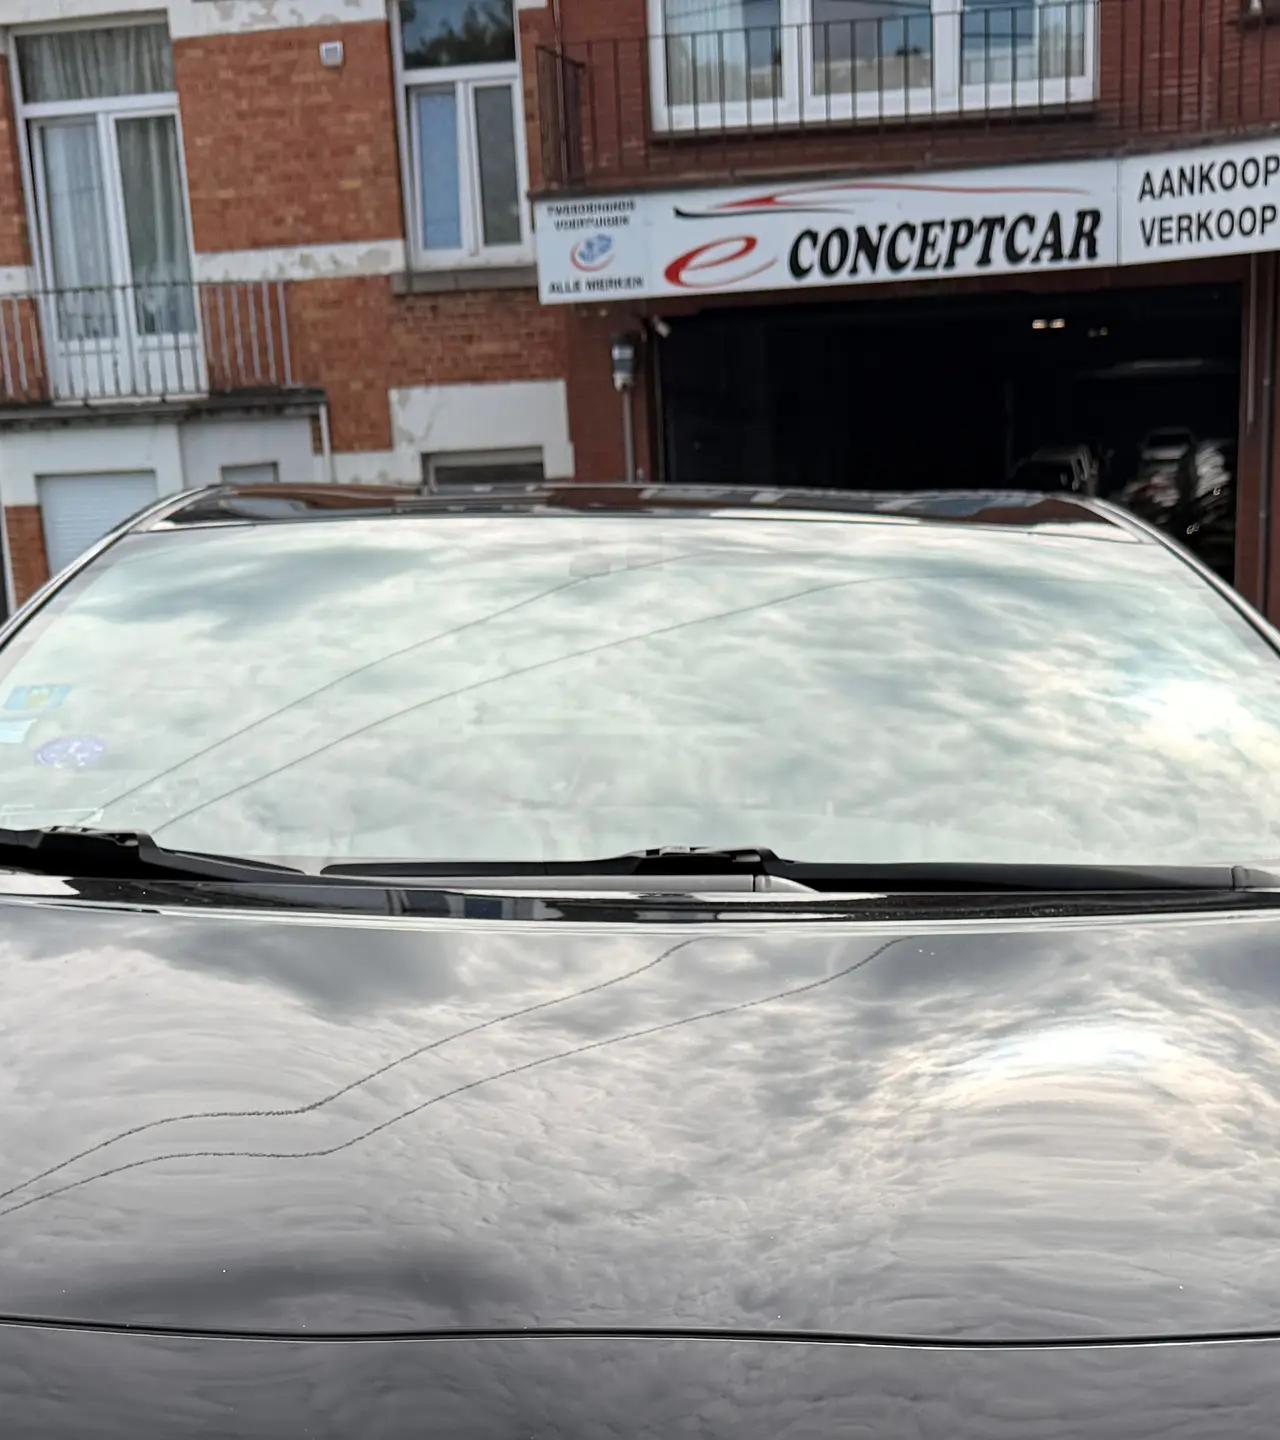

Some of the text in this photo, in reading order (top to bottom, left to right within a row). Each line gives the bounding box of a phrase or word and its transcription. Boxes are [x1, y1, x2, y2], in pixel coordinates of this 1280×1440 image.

[1138, 155, 1280, 202] AANKOOP
[1140, 203, 1277, 247] VERKOOP
[664, 209, 1101, 288] e CONCEPTCAR
[549, 276, 643, 294] ALLE MERKEN
